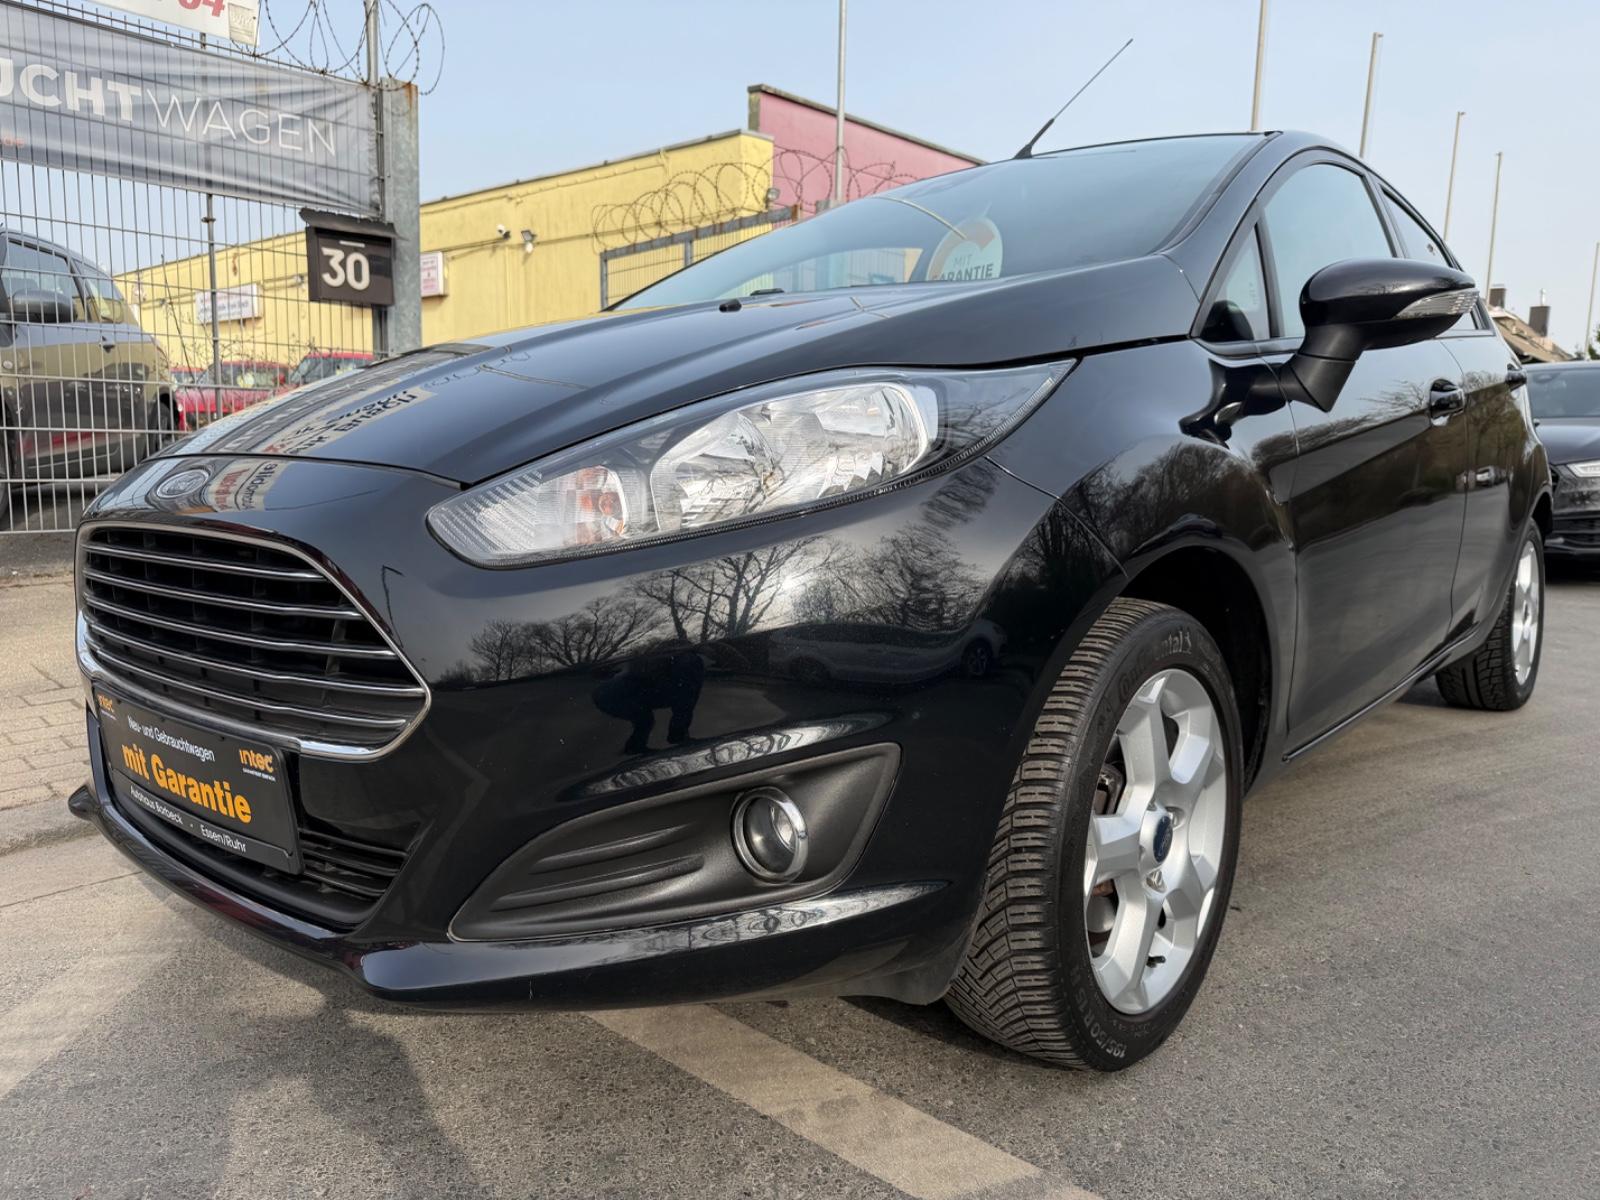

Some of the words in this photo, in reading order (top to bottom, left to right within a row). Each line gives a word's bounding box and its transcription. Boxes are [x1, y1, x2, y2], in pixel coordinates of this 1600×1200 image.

[320, 247, 370, 291] 30
[142, 725, 154, 740] und
[154, 727, 215, 763] Gebrauchtwagen
[239, 749, 274, 774] intec
[122, 744, 149, 781] mit
[151, 754, 252, 824] Garantie
[200, 823, 247, 853] Essen/Ruhr
